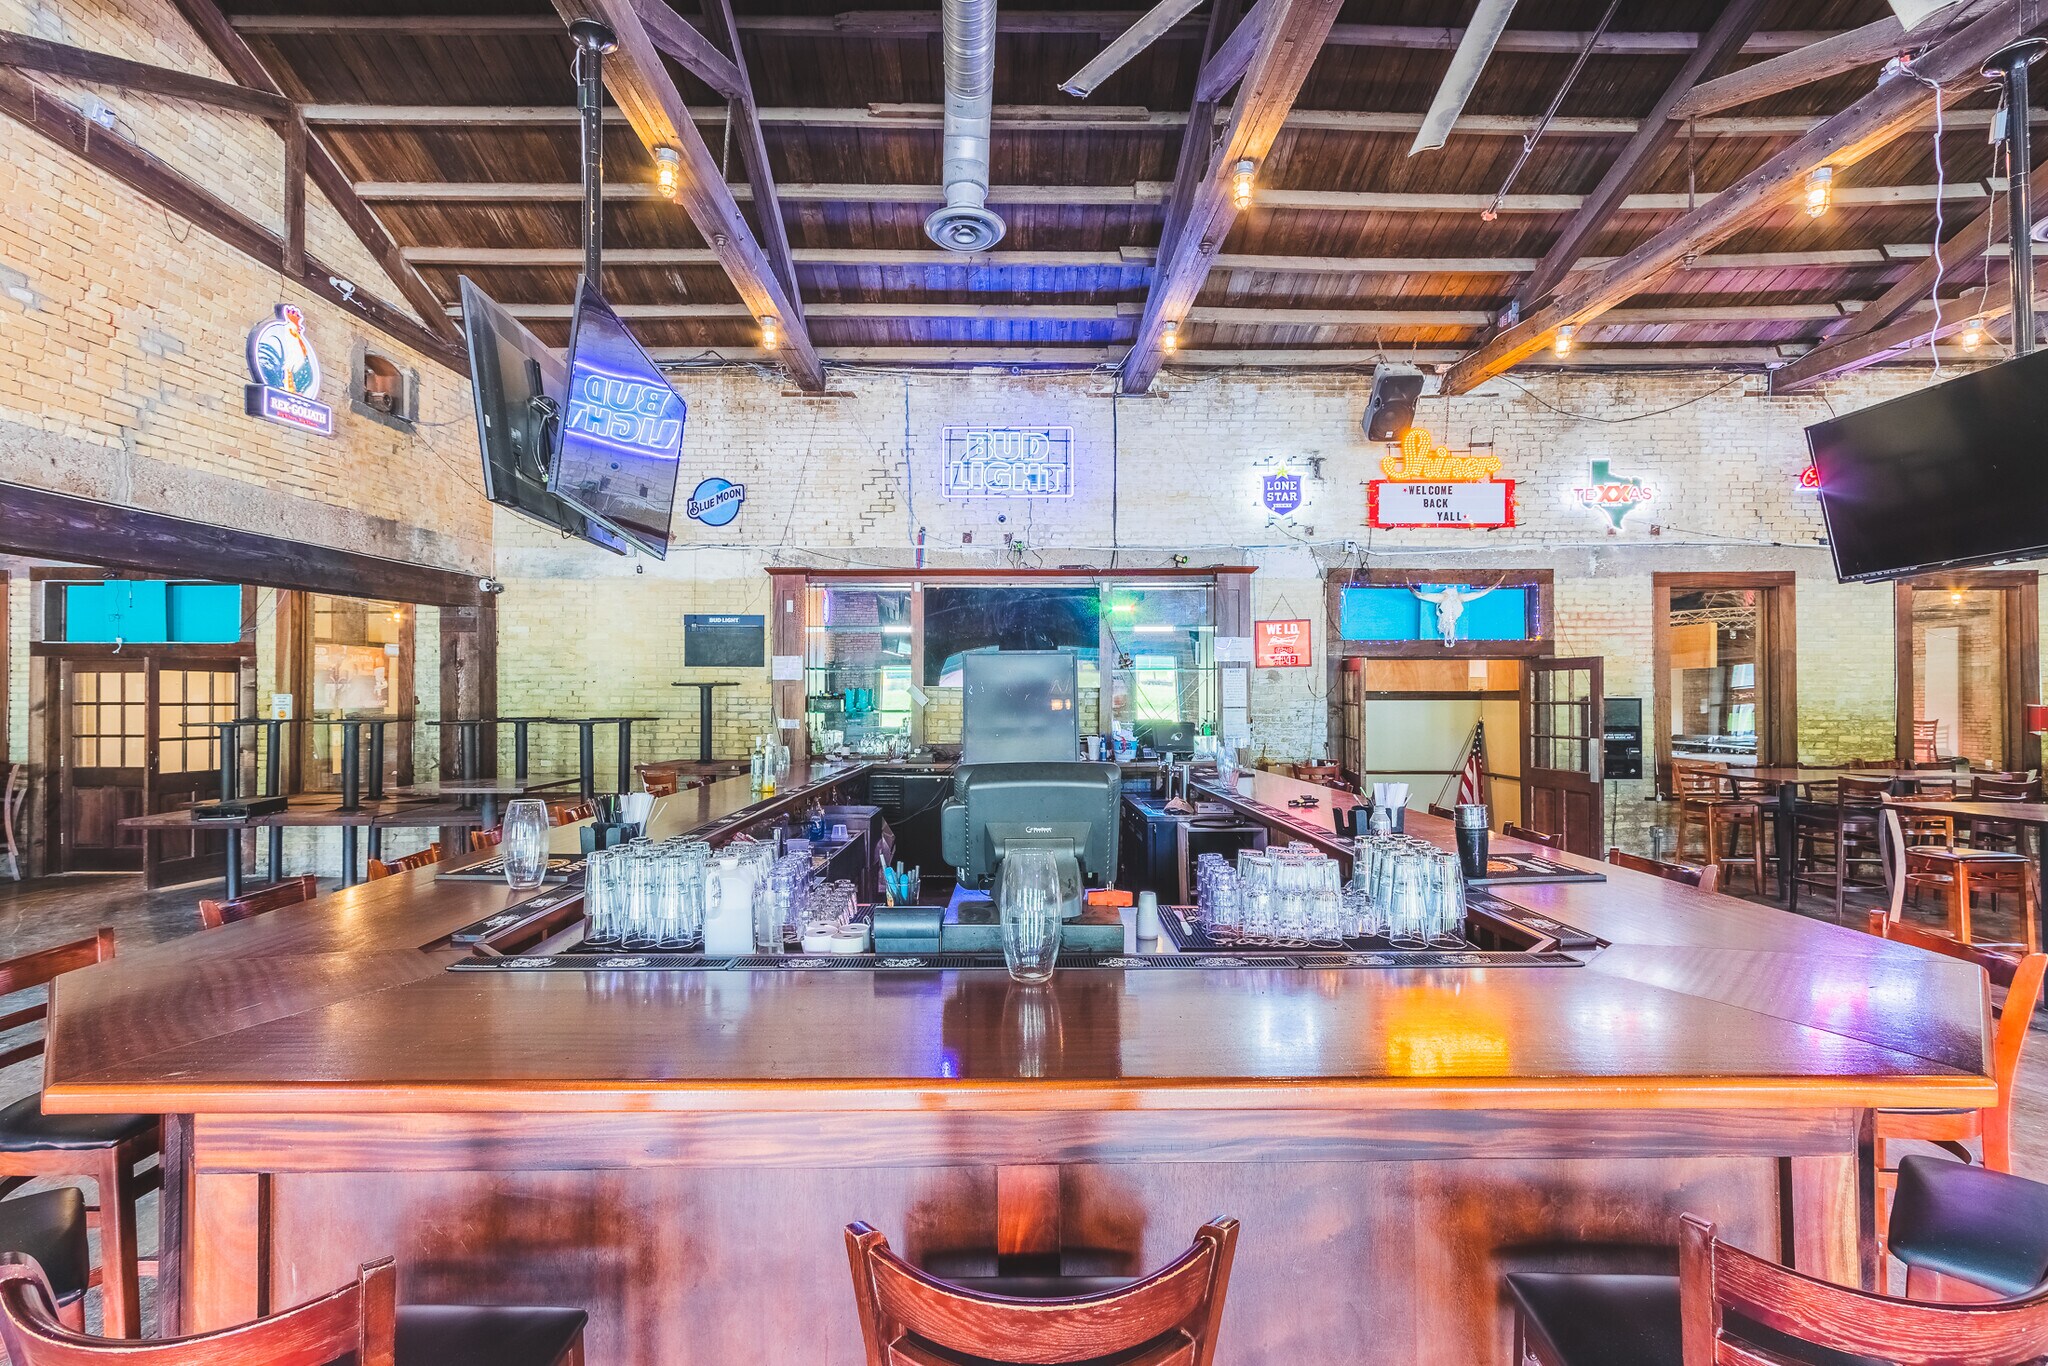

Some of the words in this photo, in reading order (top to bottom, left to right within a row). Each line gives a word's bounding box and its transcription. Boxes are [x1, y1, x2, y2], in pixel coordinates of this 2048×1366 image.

[966, 431, 1050, 461] BUD
[1381, 428, 1502, 478] Shiner
[949, 461, 1066, 492] LIGHT
[1266, 481, 1298, 491] LONE
[1408, 485, 1454, 496] WELCOME
[1266, 491, 1298, 502] STAR
[1573, 484, 1653, 502] TEXXAS
[690, 498, 715, 516] BLUE
[715, 488, 741, 505] MOON
[1423, 498, 1449, 508] BACK
[1436, 511, 1463, 521] YALL
[1265, 623, 1283, 635] WE
